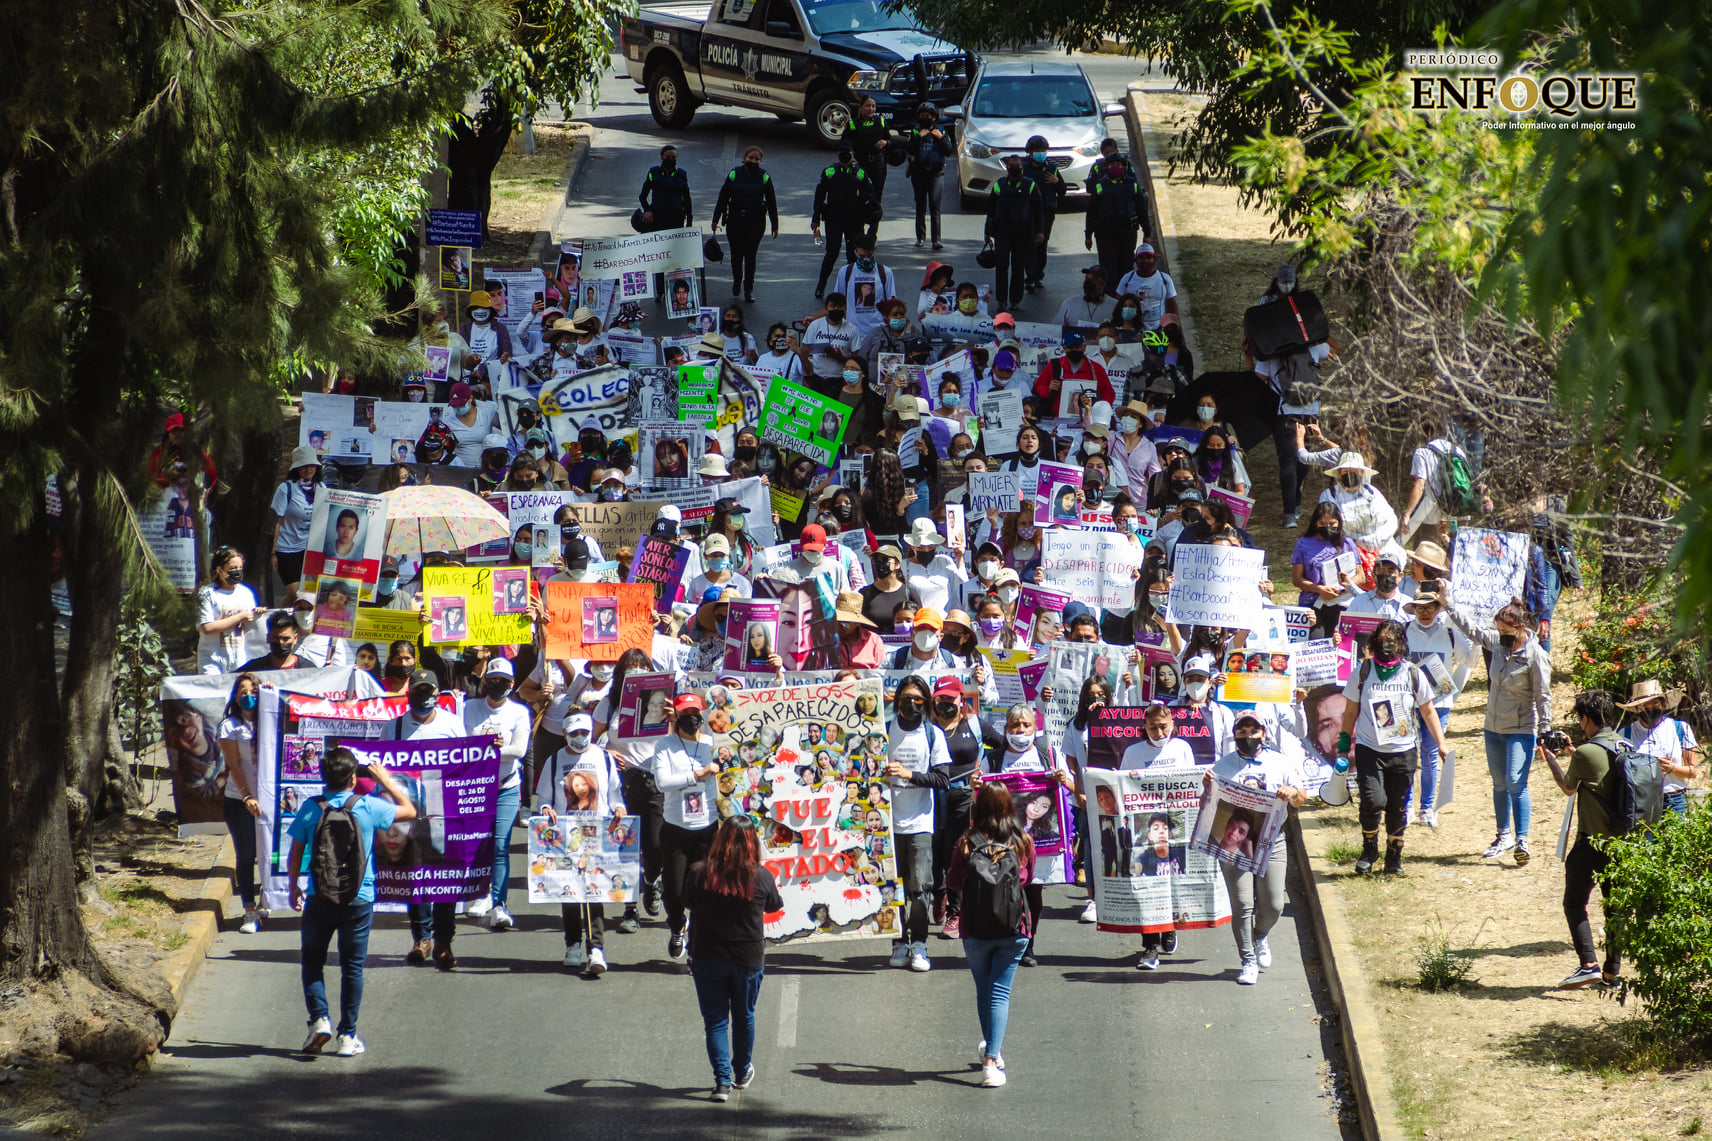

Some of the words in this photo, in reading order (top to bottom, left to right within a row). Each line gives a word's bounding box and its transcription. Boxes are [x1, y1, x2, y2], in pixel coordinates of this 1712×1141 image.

[707, 43, 738, 66] POLICÍA
[761, 54, 793, 76] MUNICIPAL
[732, 83, 769, 98] TRÁNSITO
[763, 425, 825, 463] DESAPARECIDA
[974, 475, 1016, 492] MUJER
[510, 494, 562, 510] ESPERANZA
[646, 540, 671, 556] AYER
[1044, 531, 1072, 556] Tengo
[1044, 558, 1133, 575] DESAPARECIDO
[425, 571, 449, 587] VIVA
[1045, 574, 1066, 586] hace
[1075, 576, 1095, 586] seis
[1169, 606, 1184, 620] No
[1188, 611, 1209, 620] son
[470, 626, 496, 640] VIVA
[746, 678, 770, 690] Voz
[751, 690, 777, 704] VOZ
[783, 688, 799, 700] DE
[806, 685, 842, 700] LOS
[729, 698, 873, 744] DESAPARECIDOS
[445, 775, 496, 788] DESAPARECIÓ
[1140, 783, 1155, 792] SE
[1157, 781, 1199, 792] BUSCA:
[477, 786, 486, 794] DE
[1123, 792, 1163, 803] EDWIN
[1166, 790, 1201, 801] ARIEL
[457, 796, 486, 805] AGOSTO
[1124, 802, 1155, 811] REYES
[774, 797, 832, 821] FUE
[801, 827, 838, 849] EL
[394, 868, 432, 881] GARCÍA
[433, 866, 492, 880] HERNÁNDEZ
[764, 852, 851, 879] STADO
[376, 885, 411, 896] YÚDANOS
[420, 884, 480, 895] ENCONTRARLA
